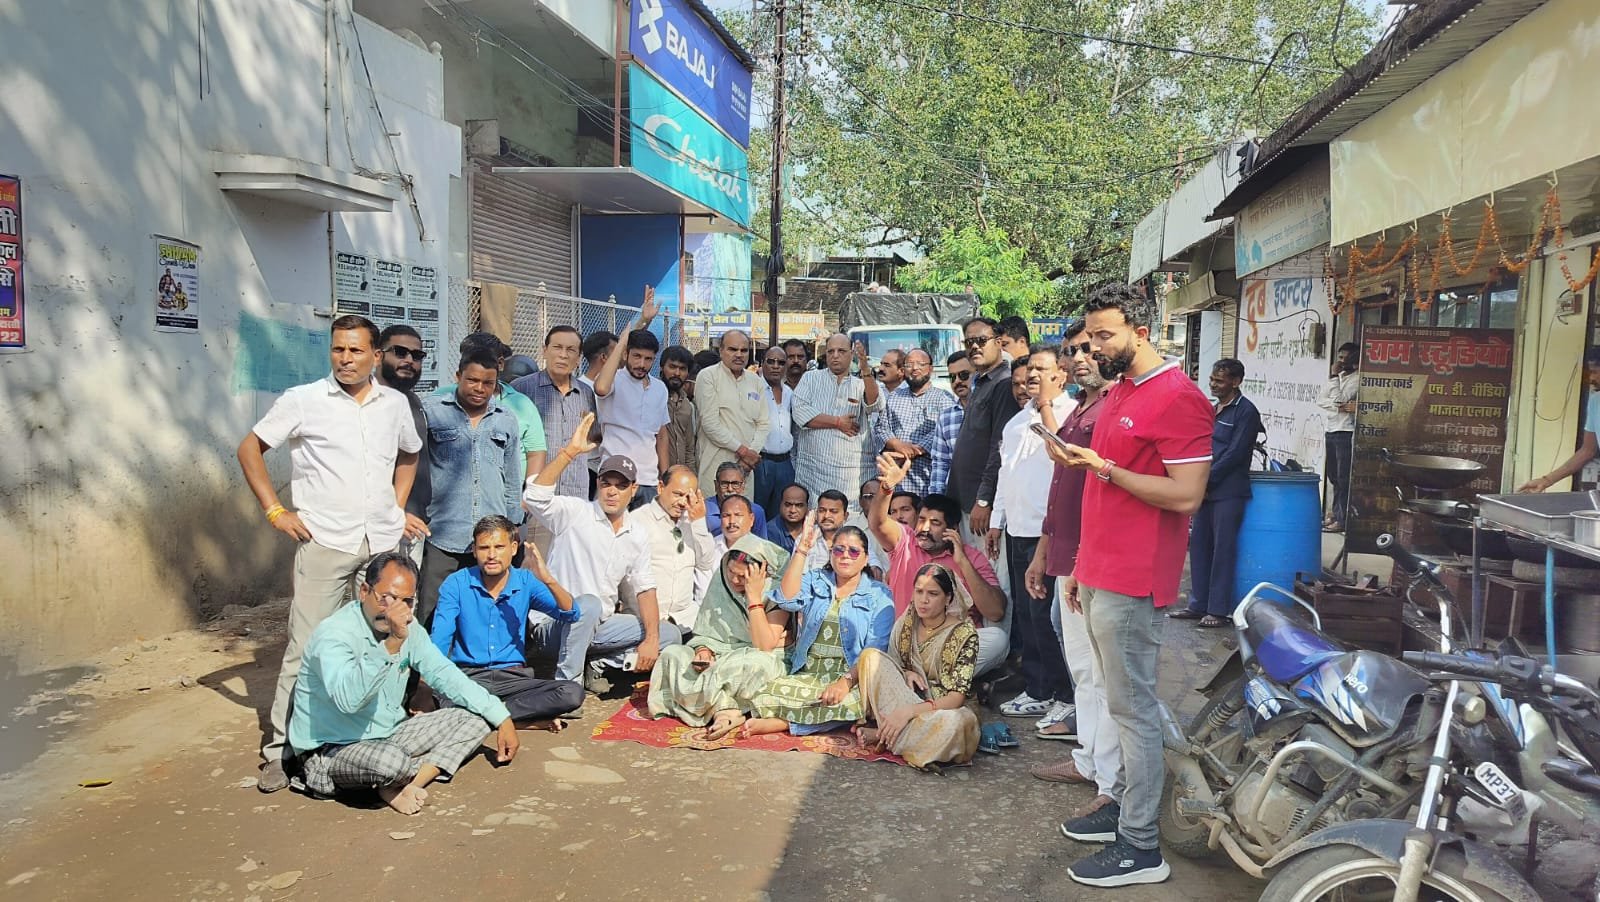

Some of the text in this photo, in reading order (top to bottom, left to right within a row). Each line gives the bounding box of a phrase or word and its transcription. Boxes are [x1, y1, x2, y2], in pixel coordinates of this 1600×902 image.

[665, 20, 715, 89] BAJAJ
[643, 114, 742, 203] Chetak
[1365, 336, 1511, 375] राम स्टूडियो
[1361, 377, 1391, 388] आधार
[1480, 767, 1517, 801] MP37
